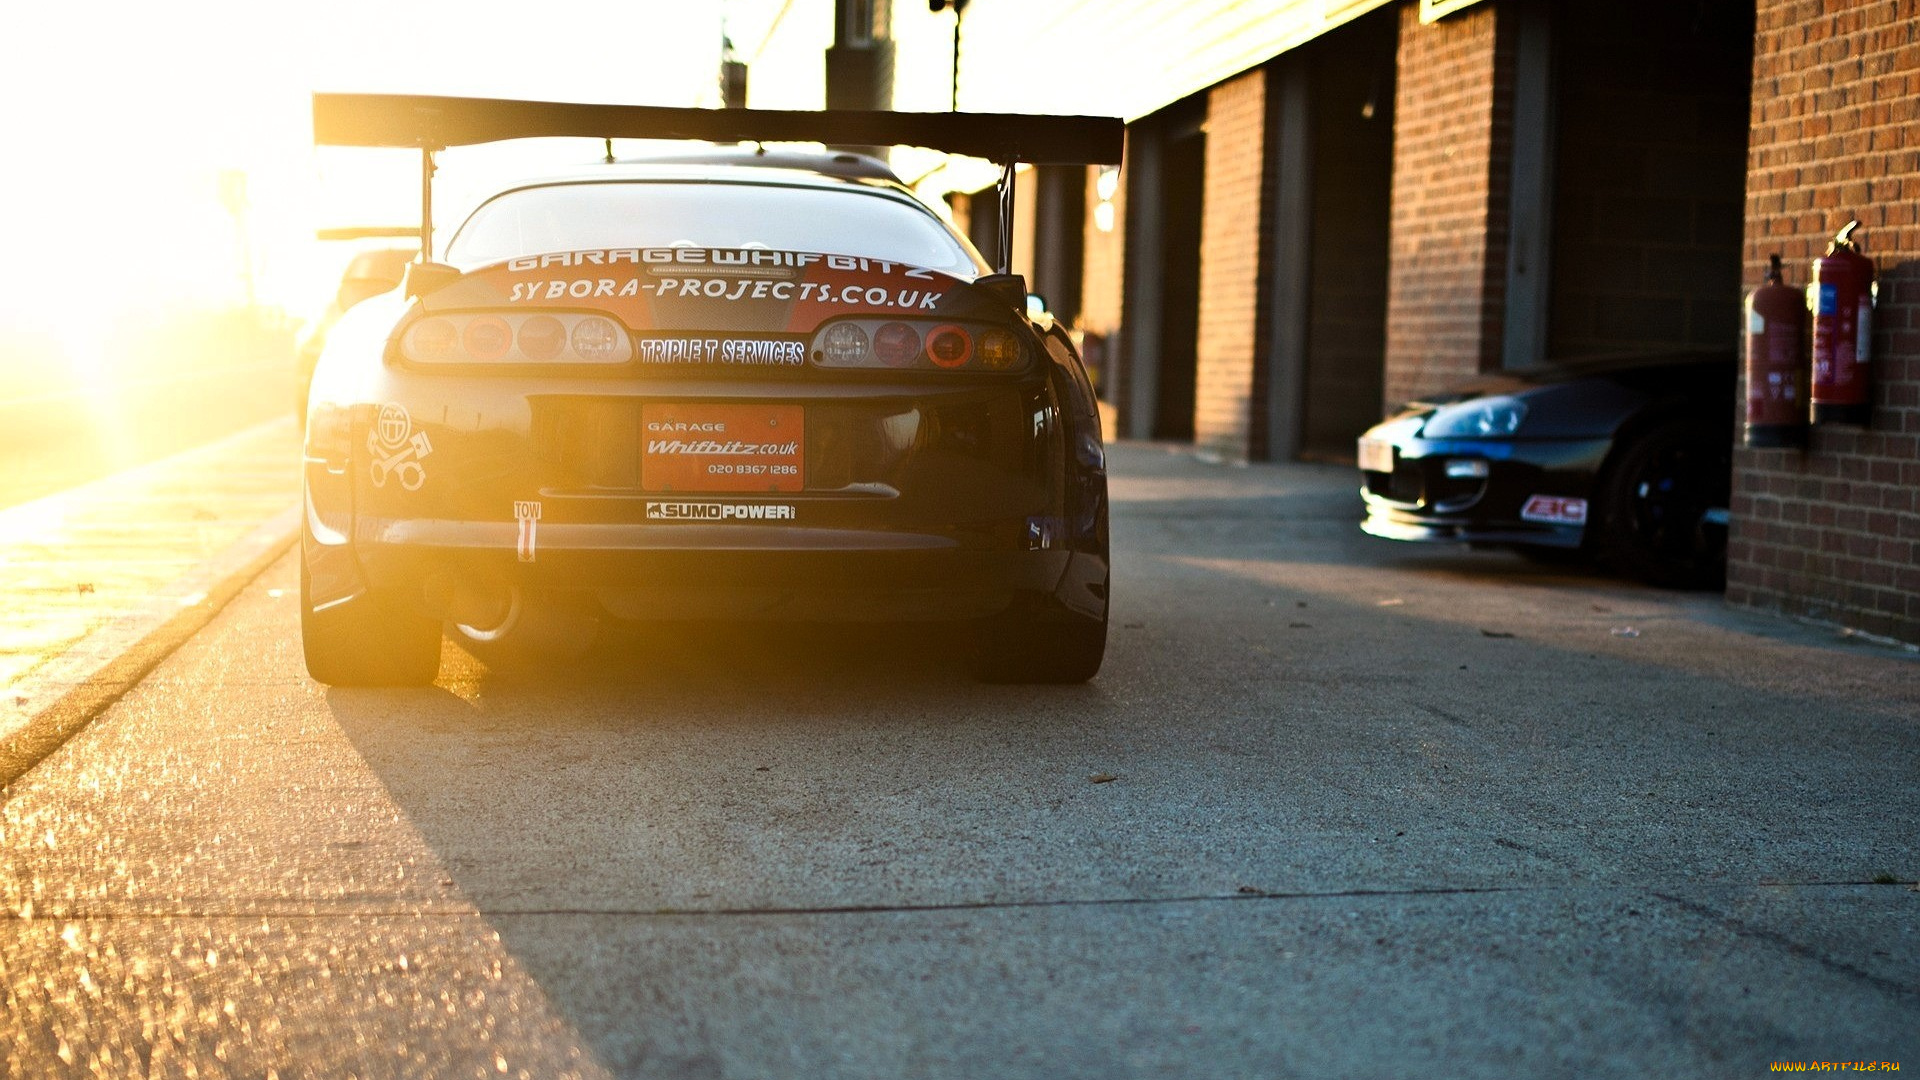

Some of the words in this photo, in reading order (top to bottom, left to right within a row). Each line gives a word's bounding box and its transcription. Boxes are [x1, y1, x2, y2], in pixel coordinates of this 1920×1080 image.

[509, 278, 942, 310] SYBORA-PROJECTS.CO.UK
[641, 339, 701, 364] TRIPLE
[705, 339, 718, 364] T
[722, 340, 804, 367] SERVICES
[647, 422, 725, 432] GARAGE
[647, 439, 798, 455] Whifbitz.co.uk
[708, 465, 734, 475] 020
[736, 465, 767, 475] 8367
[770, 465, 798, 475] 1286
[515, 502, 540, 518] TOW
